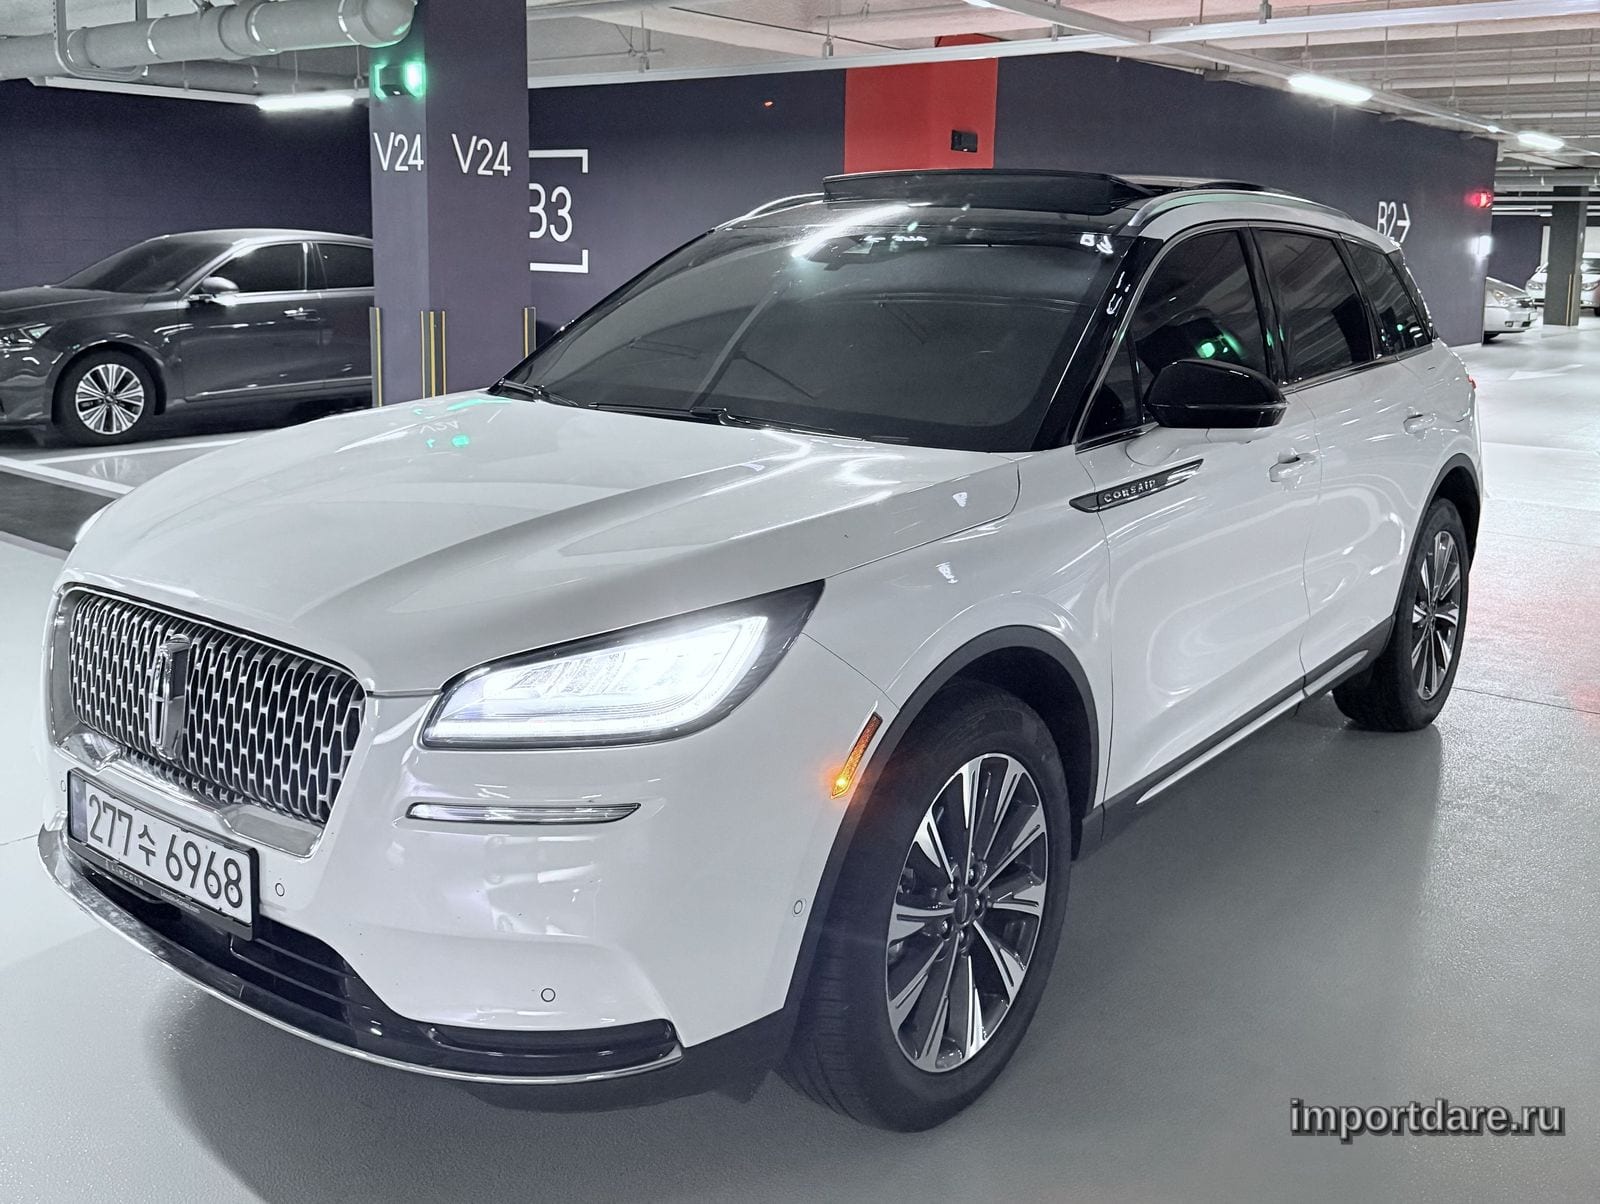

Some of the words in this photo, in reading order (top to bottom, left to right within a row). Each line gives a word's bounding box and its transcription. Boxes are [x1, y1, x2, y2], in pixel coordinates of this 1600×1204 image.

[373, 132, 424, 171] V24
[451, 133, 511, 177] V24
[1377, 201, 1397, 239] B2
[165, 834, 243, 908] 6968
